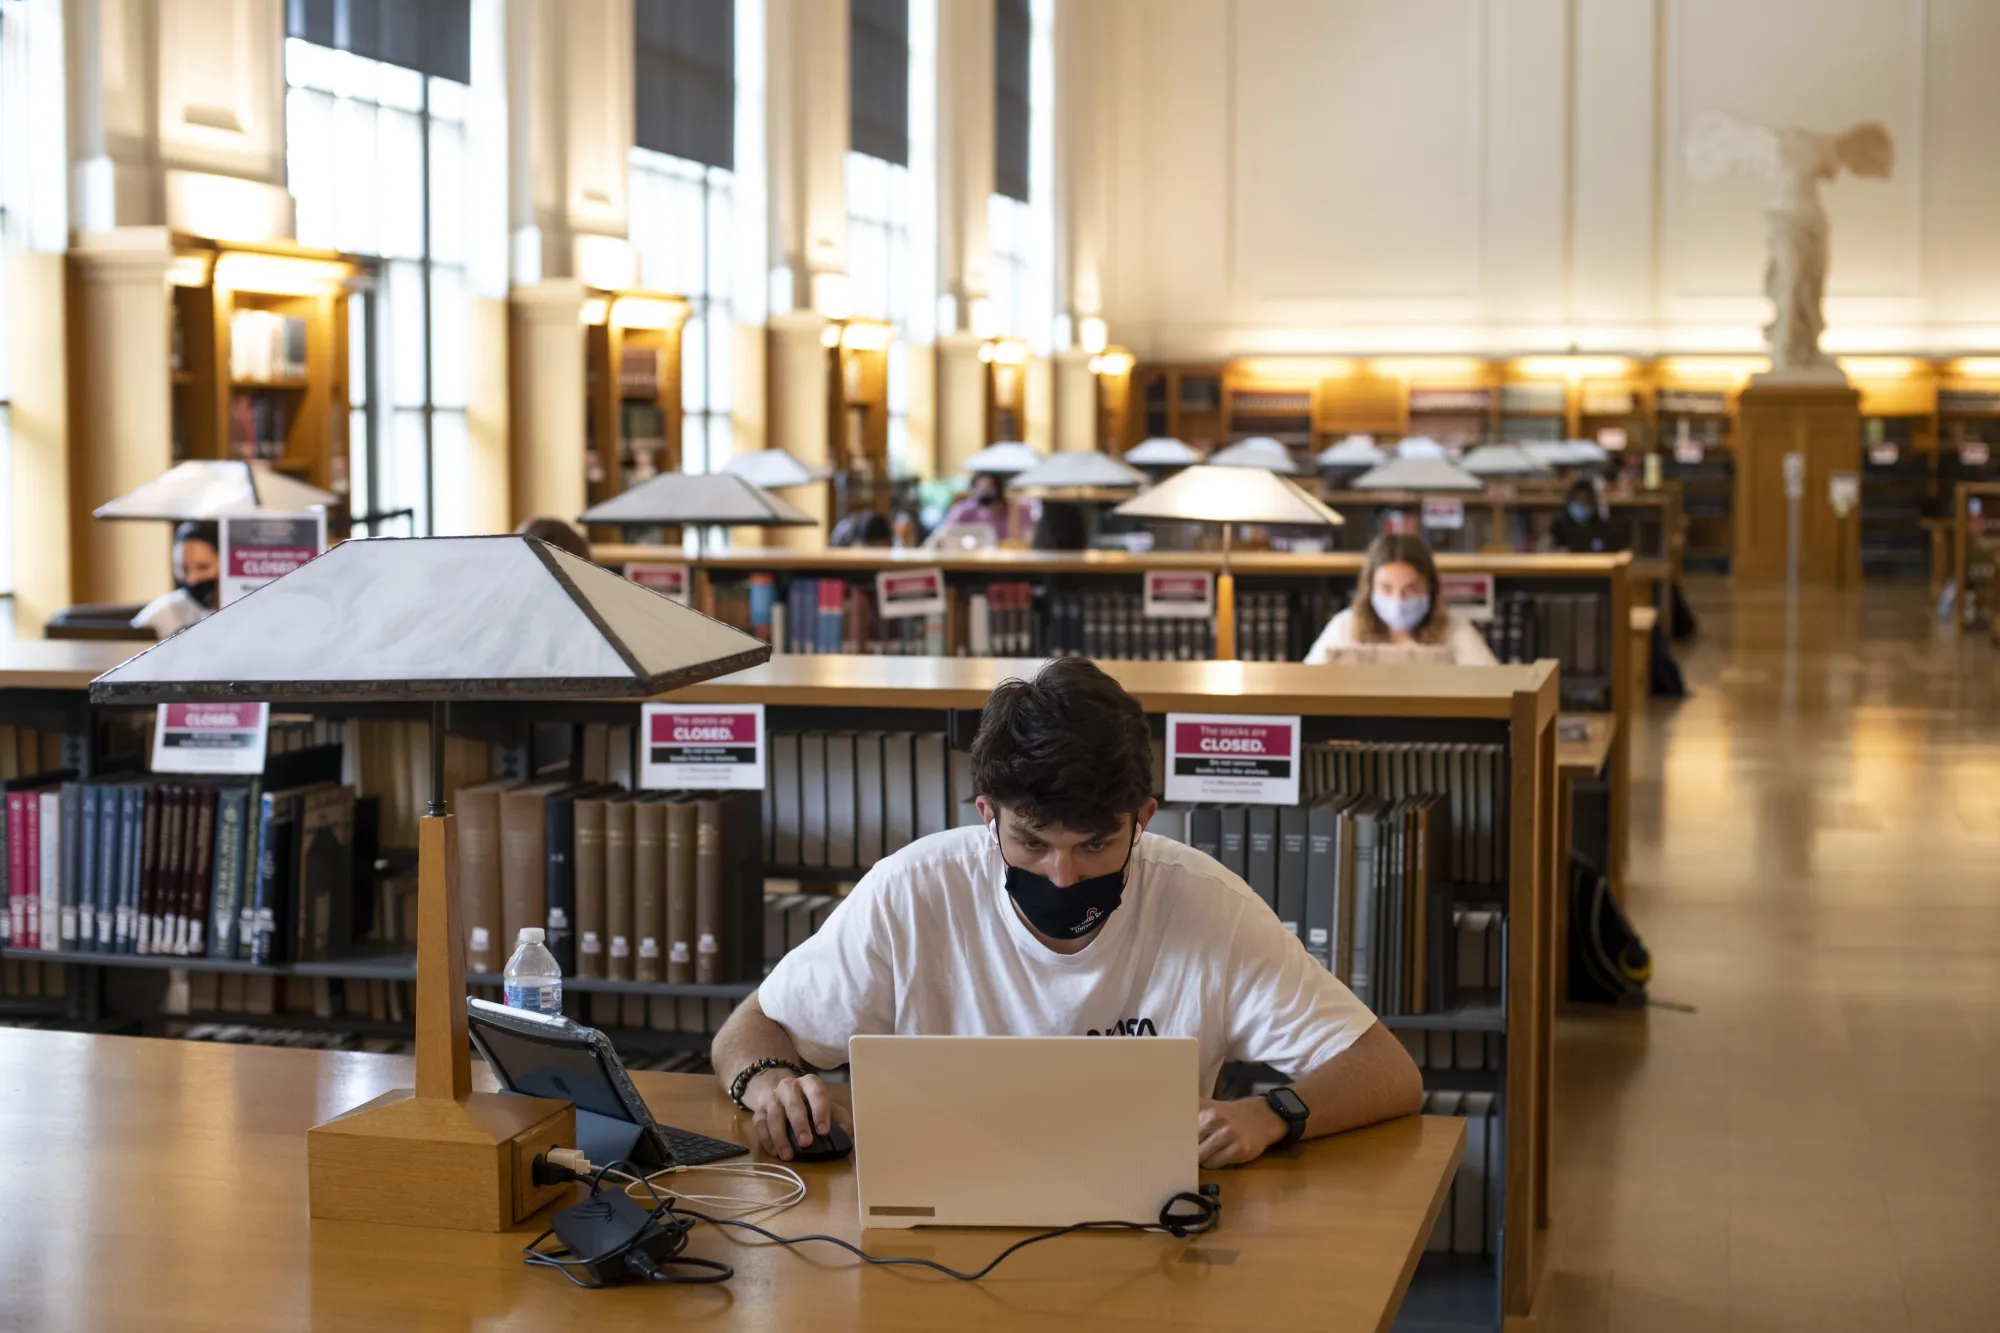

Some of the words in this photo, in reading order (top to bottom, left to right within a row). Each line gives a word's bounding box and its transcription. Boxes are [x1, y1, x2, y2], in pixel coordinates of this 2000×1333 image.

[673, 727, 734, 741] CLOSED.
[1200, 725, 1218, 736] The
[1220, 726, 1249, 737] stacks
[1251, 728, 1268, 737] are
[1200, 738, 1267, 753] CLOSED.
